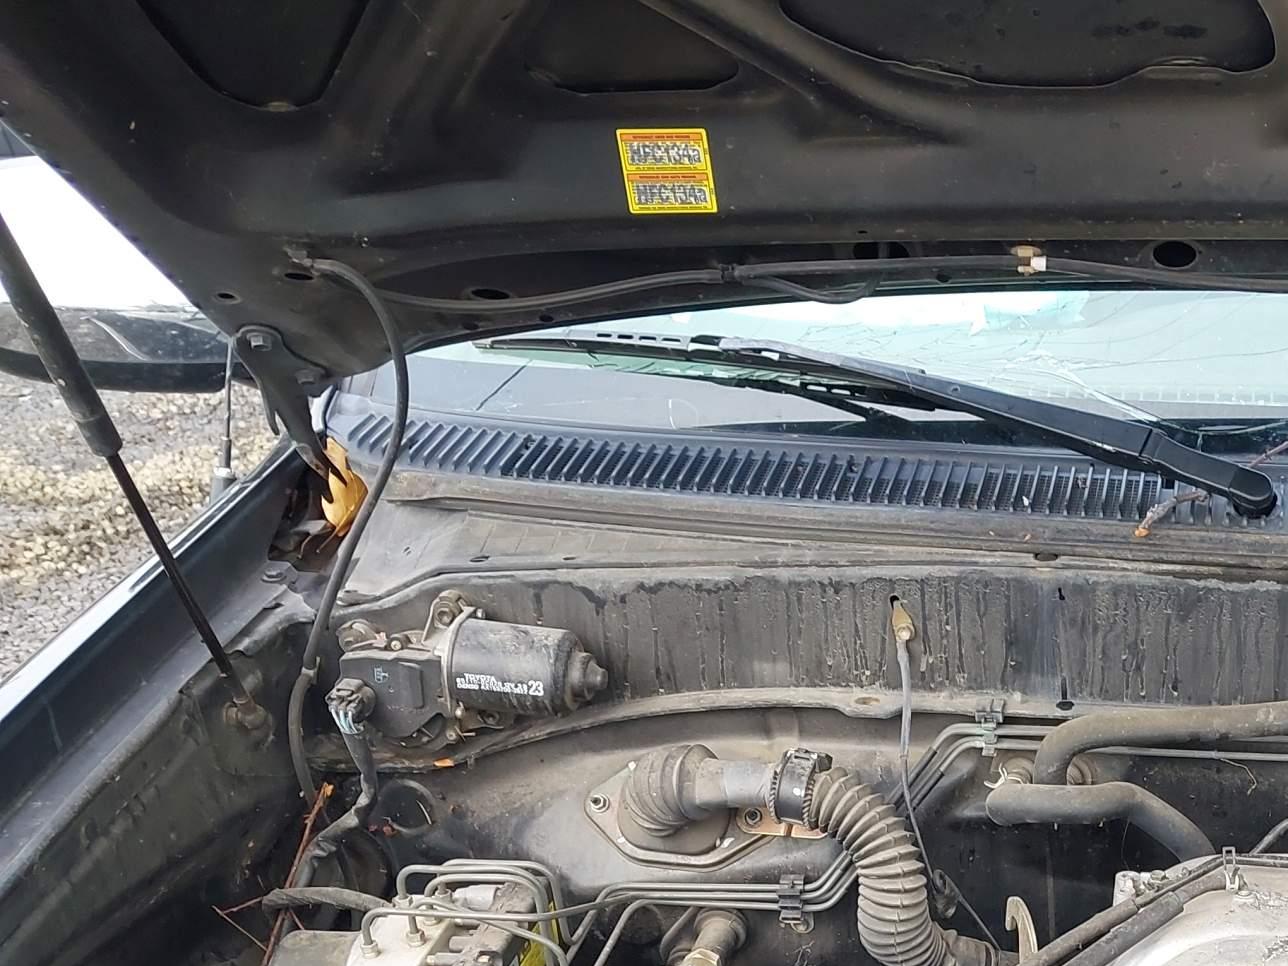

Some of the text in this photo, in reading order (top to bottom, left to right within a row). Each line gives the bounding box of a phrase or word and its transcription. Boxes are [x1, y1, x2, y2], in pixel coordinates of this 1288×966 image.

[628, 142, 702, 163] HFC134a
[635, 181, 708, 202] HFC134a
[528, 680, 544, 696] 23
